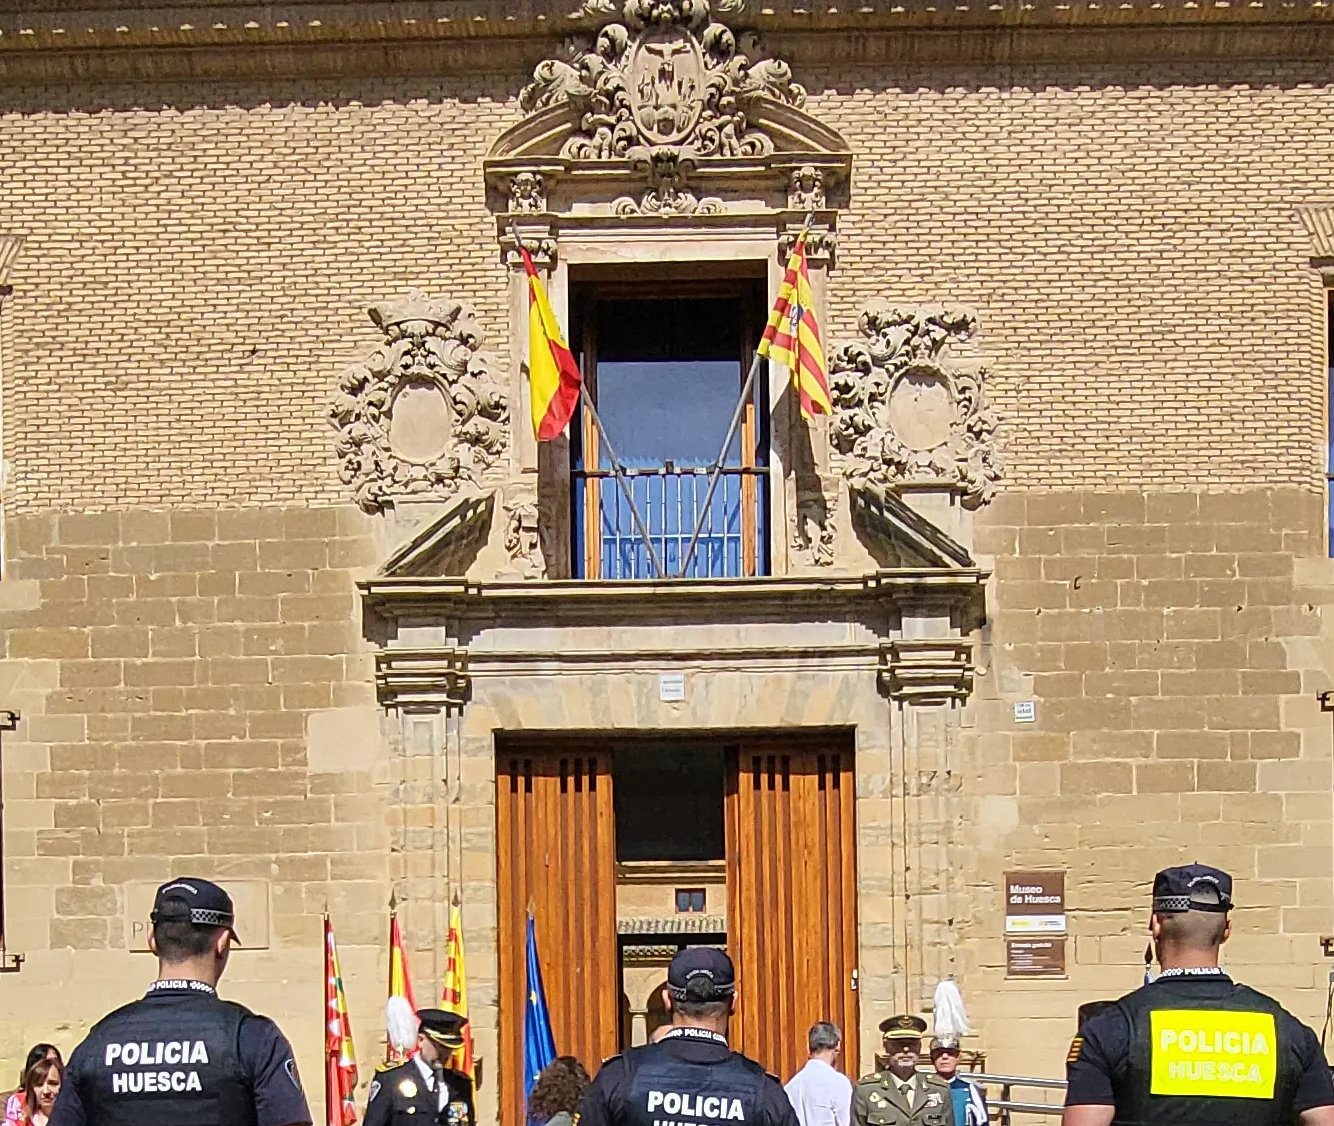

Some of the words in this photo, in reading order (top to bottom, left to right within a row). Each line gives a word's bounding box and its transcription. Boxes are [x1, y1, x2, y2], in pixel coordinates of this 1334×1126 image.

[1010, 884, 1043, 894] Museo
[1010, 894, 1023, 904] de
[1024, 894, 1061, 904] Huesca
[156, 980, 188, 990] POLICIA
[105, 1040, 209, 1066] POLICIA
[1160, 1028, 1270, 1056] POLICIA
[112, 1071, 203, 1093] HUESCA
[1168, 1060, 1262, 1083] HUESCA
[647, 1090, 745, 1121] POLICIA
